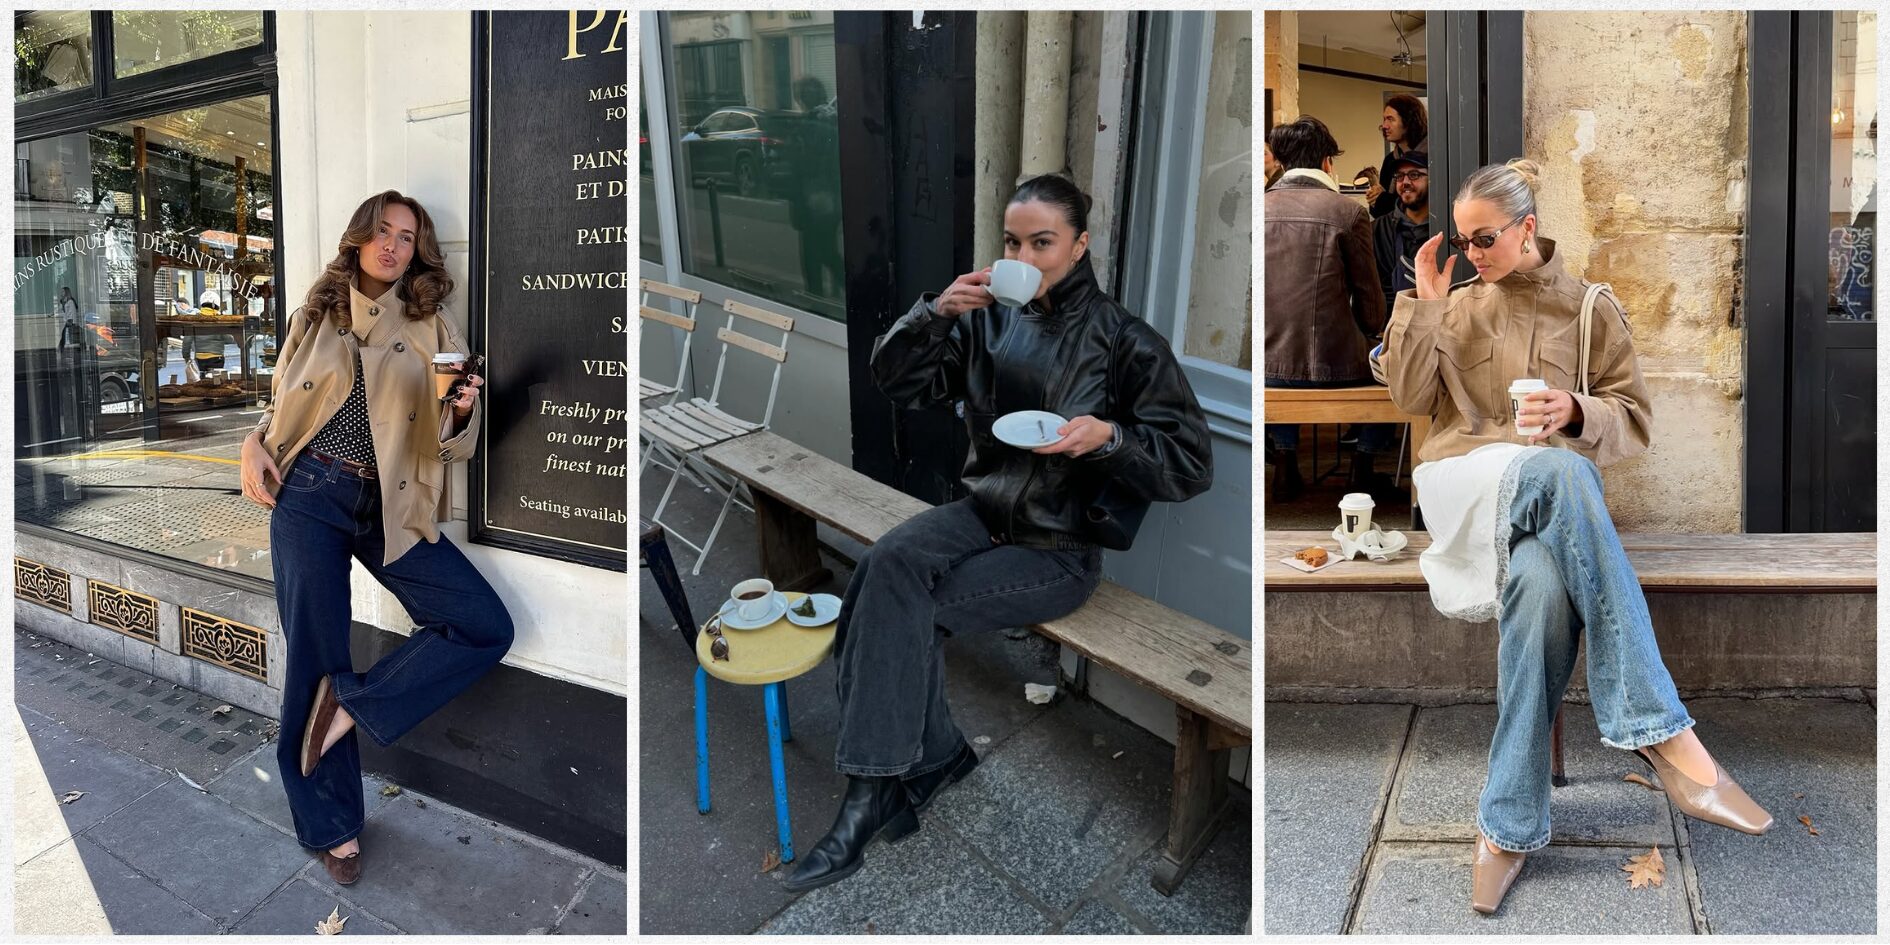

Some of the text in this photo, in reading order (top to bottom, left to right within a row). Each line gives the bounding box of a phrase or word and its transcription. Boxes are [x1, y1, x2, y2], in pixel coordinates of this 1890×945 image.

[588, 84, 627, 101] MAIS
[605, 106, 627, 120] FO
[576, 180, 627, 200] ET D
[14, 262, 35, 291] INS
[35, 232, 114, 272] RUSTIQUE
[117, 231, 137, 249] ET
[142, 232, 165, 253] DE
[169, 240, 258, 300] FANTAISIE
[611, 317, 627, 333] S
[540, 400, 601, 423] Freshly
[547, 431, 627, 453] on our pr
[543, 454, 592, 473] finest
[520, 495, 627, 524] Seating availab
